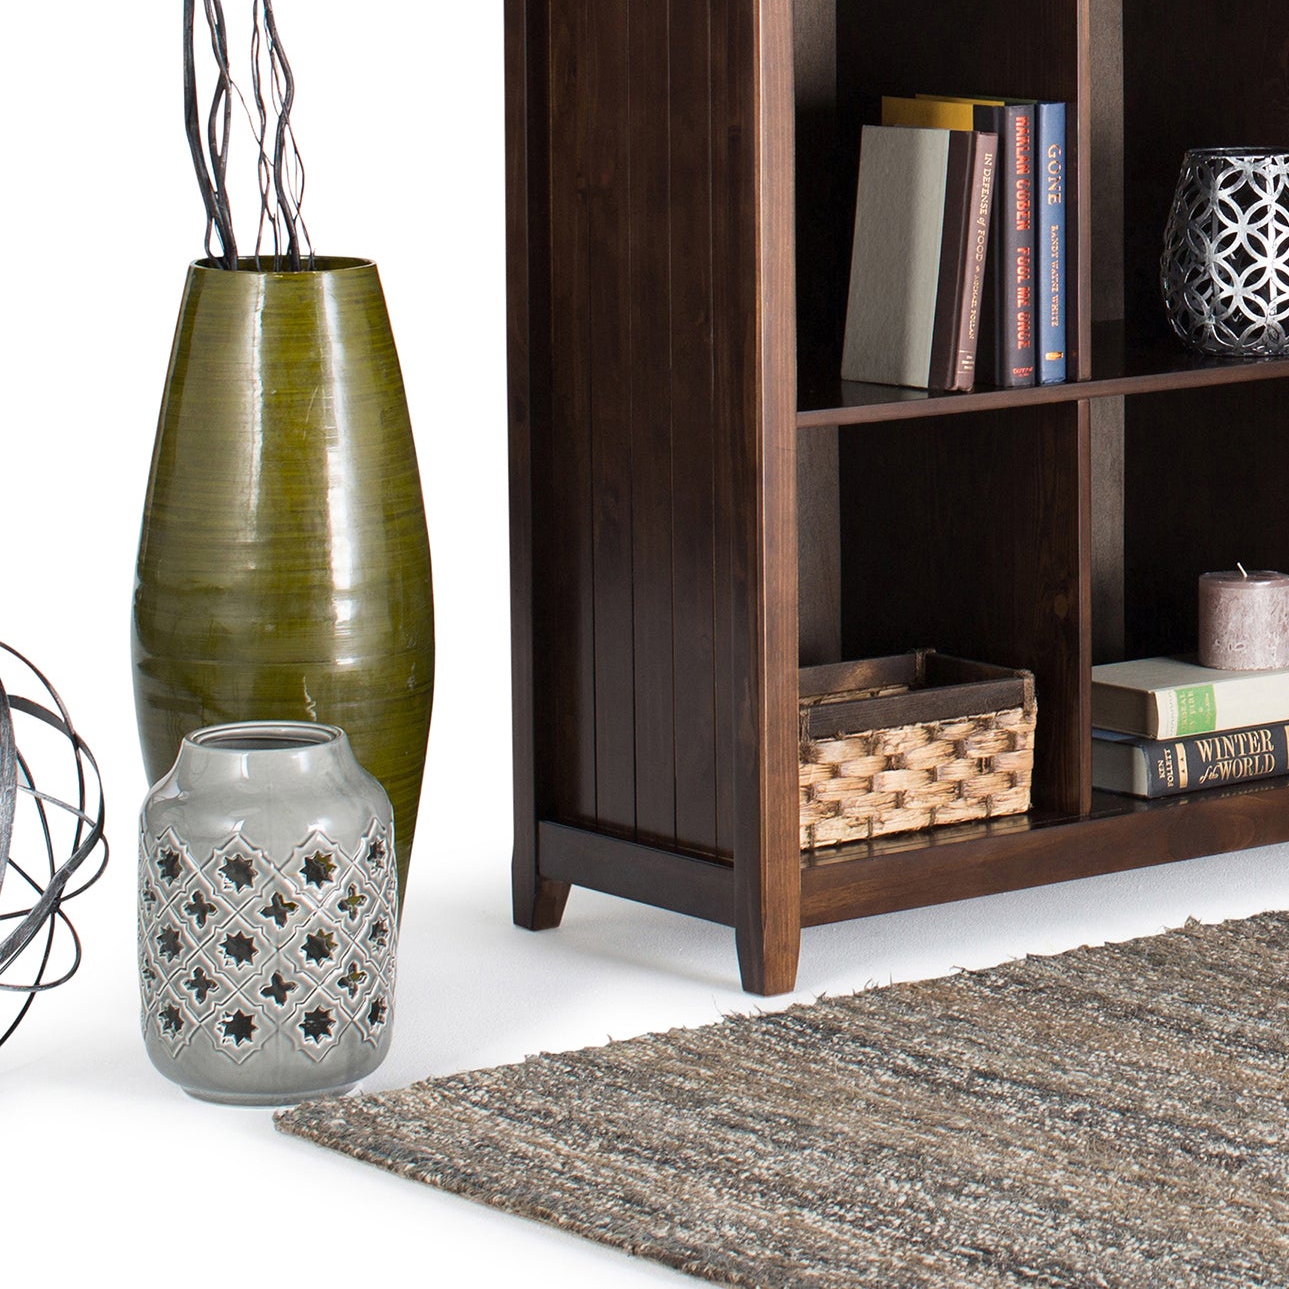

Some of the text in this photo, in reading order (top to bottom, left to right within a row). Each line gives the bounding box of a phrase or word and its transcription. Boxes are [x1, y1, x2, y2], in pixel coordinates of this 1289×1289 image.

[1015, 116, 1031, 231] HARLAN COBEN
[1047, 143, 1062, 206] GONE
[975, 153, 992, 262] IN DEFENSE of FOOD
[1017, 247, 1031, 350] FOOL ME ONCE
[1050, 225, 1059, 327] RANDY WAYNE WHITE
[1157, 759, 1165, 779] KEN
[1164, 748, 1174, 788] FOLLETT
[1194, 729, 1275, 763] WINTER
[1219, 753, 1276, 781] WORLD
